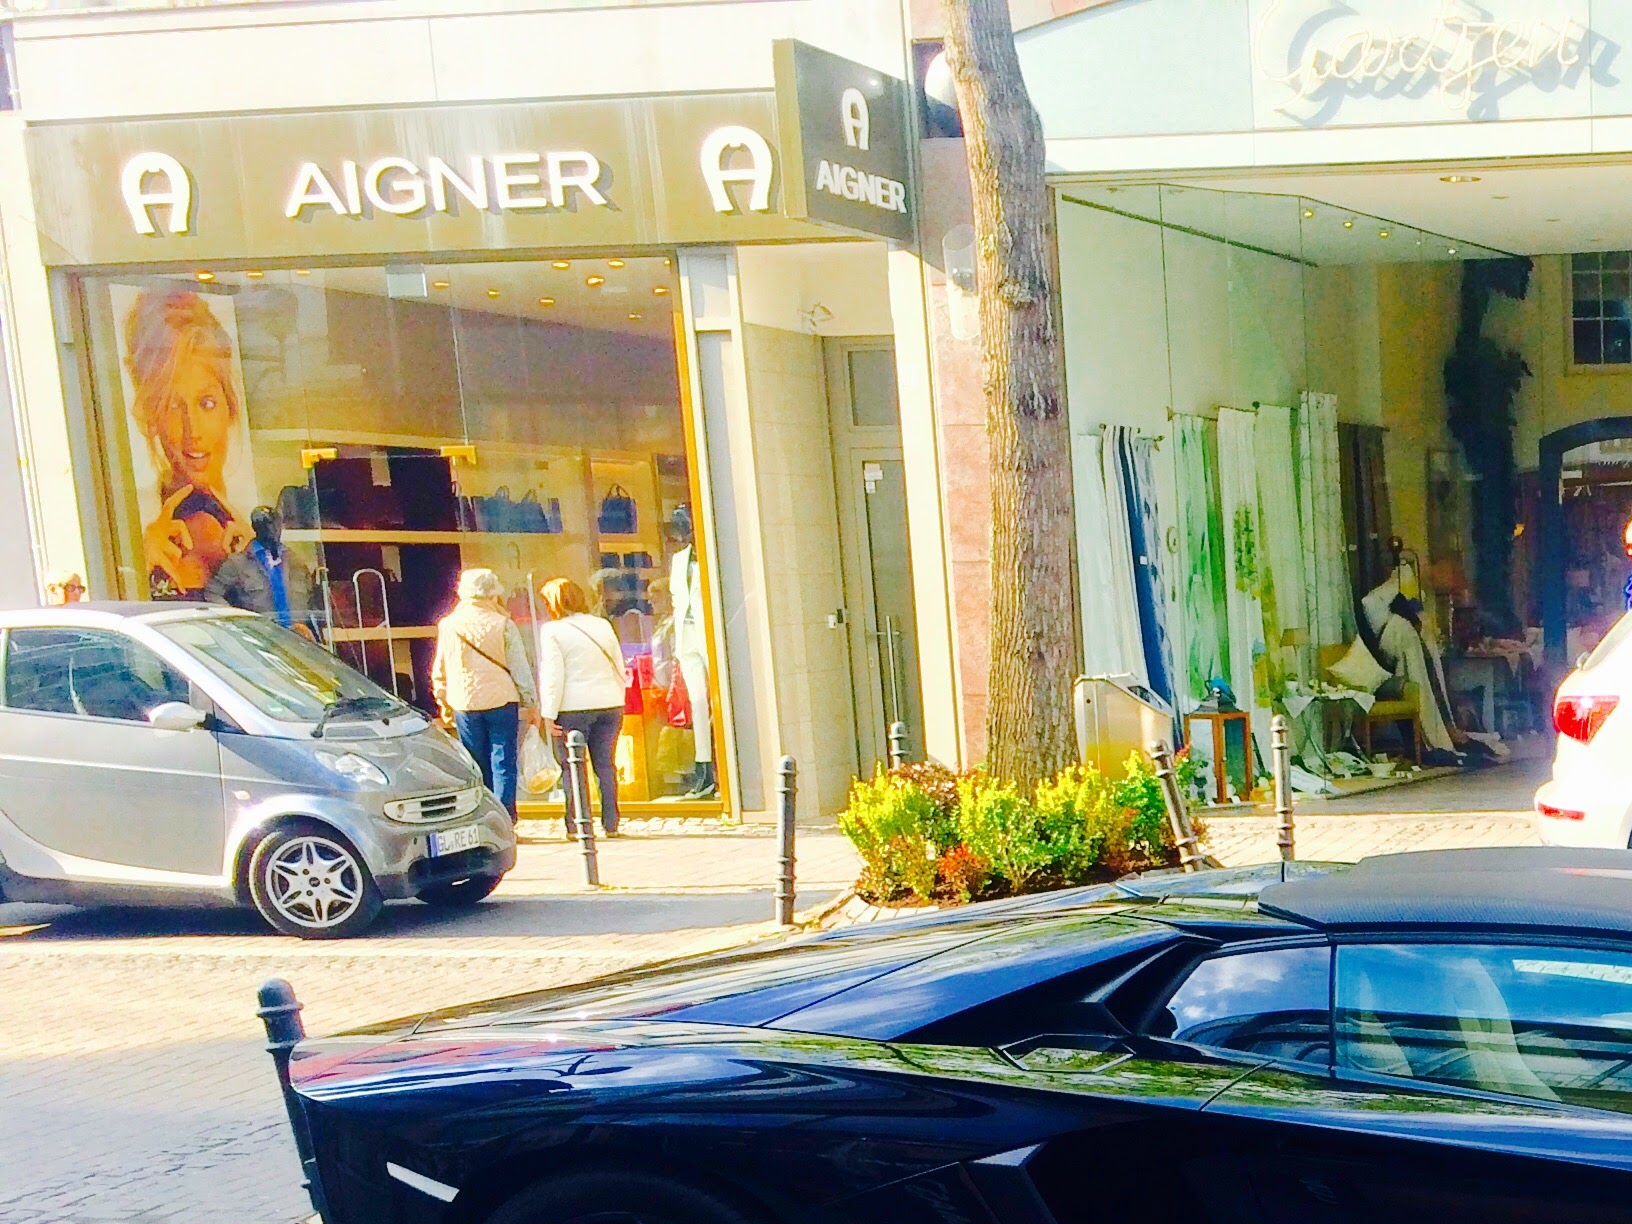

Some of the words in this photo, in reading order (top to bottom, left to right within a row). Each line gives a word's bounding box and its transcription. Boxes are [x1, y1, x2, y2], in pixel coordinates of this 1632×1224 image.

[285, 151, 608, 218] AIGNER
[816, 160, 907, 215] AIGNER
[454, 831, 467, 848] RE
[468, 828, 479, 845] 61
